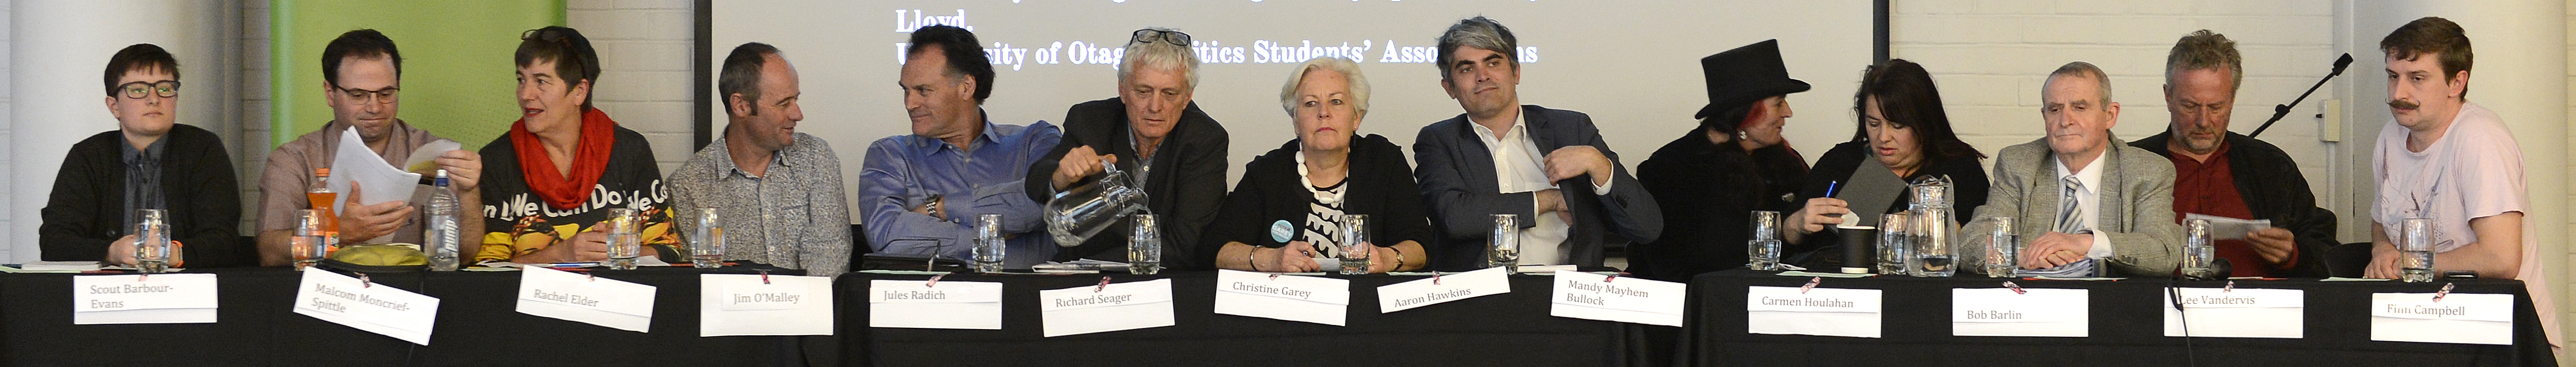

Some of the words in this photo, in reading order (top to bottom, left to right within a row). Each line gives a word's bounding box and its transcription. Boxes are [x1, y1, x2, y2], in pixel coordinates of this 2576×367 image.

[1035, 41, 1062, 65] of
[1068, 41, 1125, 70] Otag
[1254, 39, 1372, 64] Students’
[591, 183, 623, 210] Do
[90, 285, 121, 294] Scout
[124, 284, 173, 294] Barbour-
[884, 290, 908, 301] Jules
[911, 290, 946, 300] Radich
[1233, 282, 1279, 294] Christine
[1282, 287, 1311, 299] Garey
[1568, 280, 1603, 294] Mandy
[1606, 284, 1649, 298] Mayhem
[91, 299, 124, 308] Evans
[315, 283, 356, 301] Malcom
[358, 293, 410, 312] Moncrief-
[534, 289, 568, 303] Rachel
[571, 294, 599, 307] Elder
[734, 293, 751, 305] Jim
[754, 292, 800, 304] O’Malley
[1055, 295, 1095, 308] Richard
[1098, 294, 1132, 304] Seager
[1394, 296, 1425, 308] Aaron
[1427, 288, 1471, 302] Hawkins
[1567, 293, 1605, 306] Bullock
[1762, 296, 1801, 307] Carmen
[1805, 297, 1853, 308] Houlahan
[2180, 295, 2198, 304] Lee
[2201, 295, 2255, 304] Vandervis
[311, 297, 347, 313] Spittle
[2387, 303, 2411, 314] Finn
[2414, 304, 2465, 318] Campbell
[1967, 309, 1987, 320] Bob
[1990, 309, 2022, 320] Barlin
